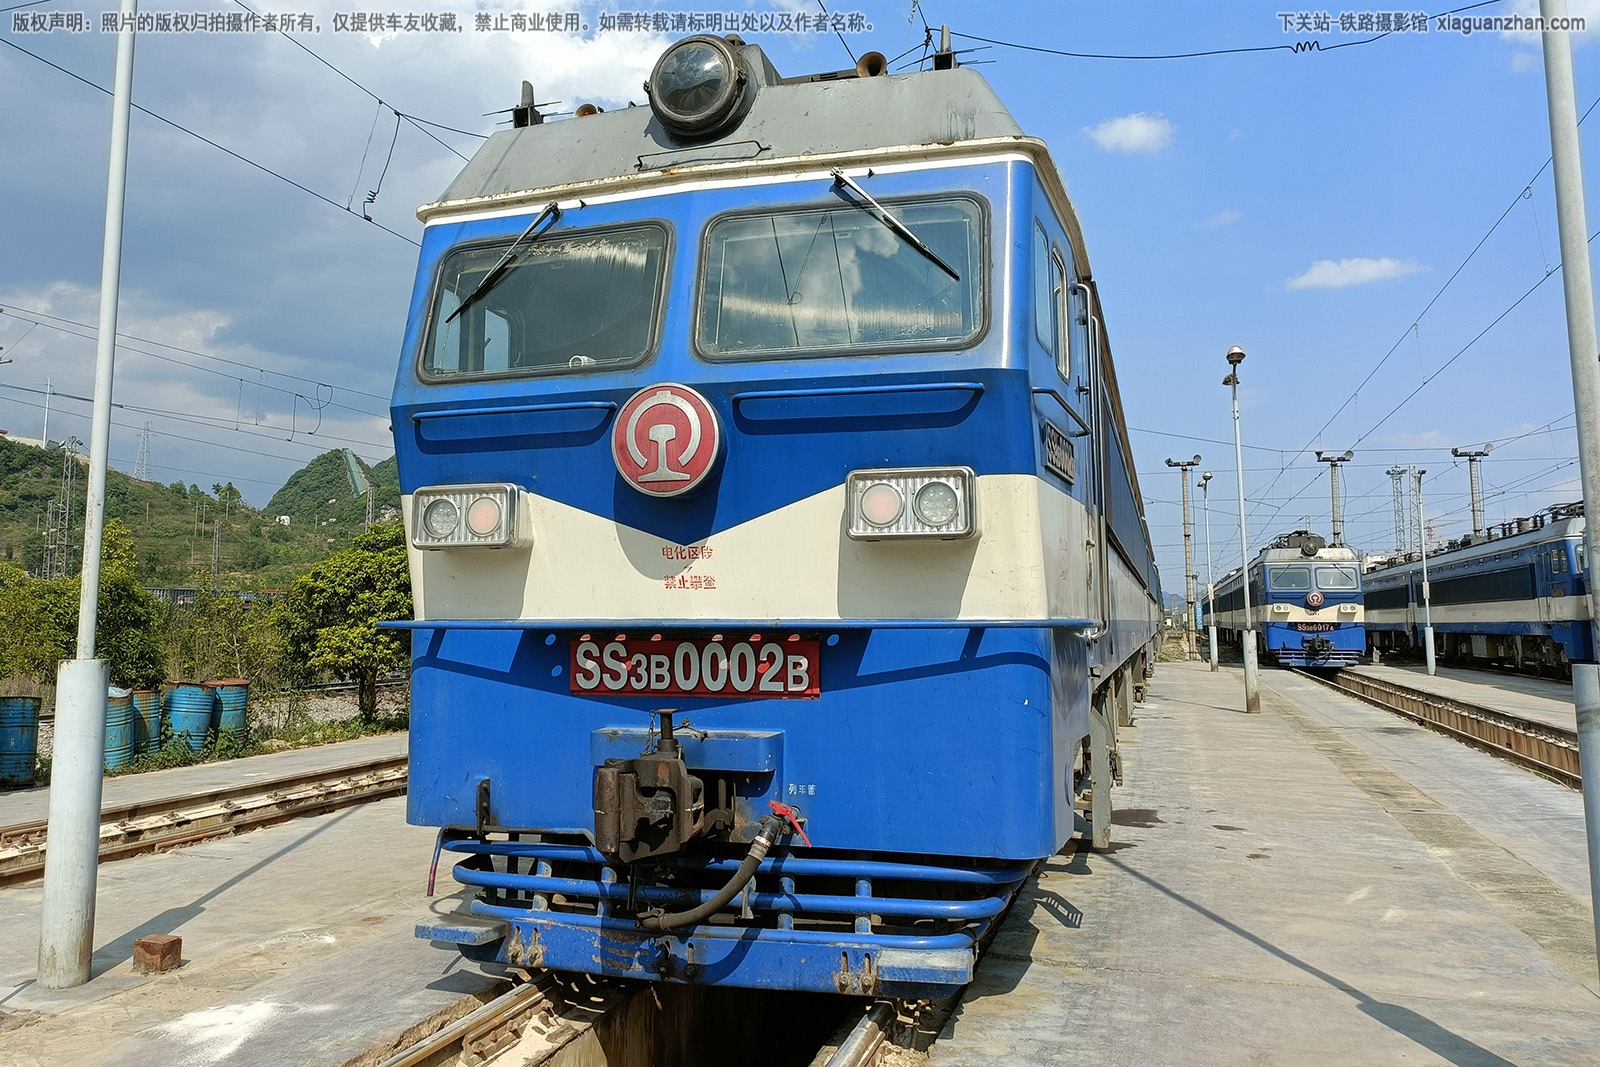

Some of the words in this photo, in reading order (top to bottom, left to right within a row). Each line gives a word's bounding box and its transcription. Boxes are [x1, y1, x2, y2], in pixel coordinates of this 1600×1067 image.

[661, 545, 714, 560] 电化区段
[575, 641, 811, 693] SS3B0002B
